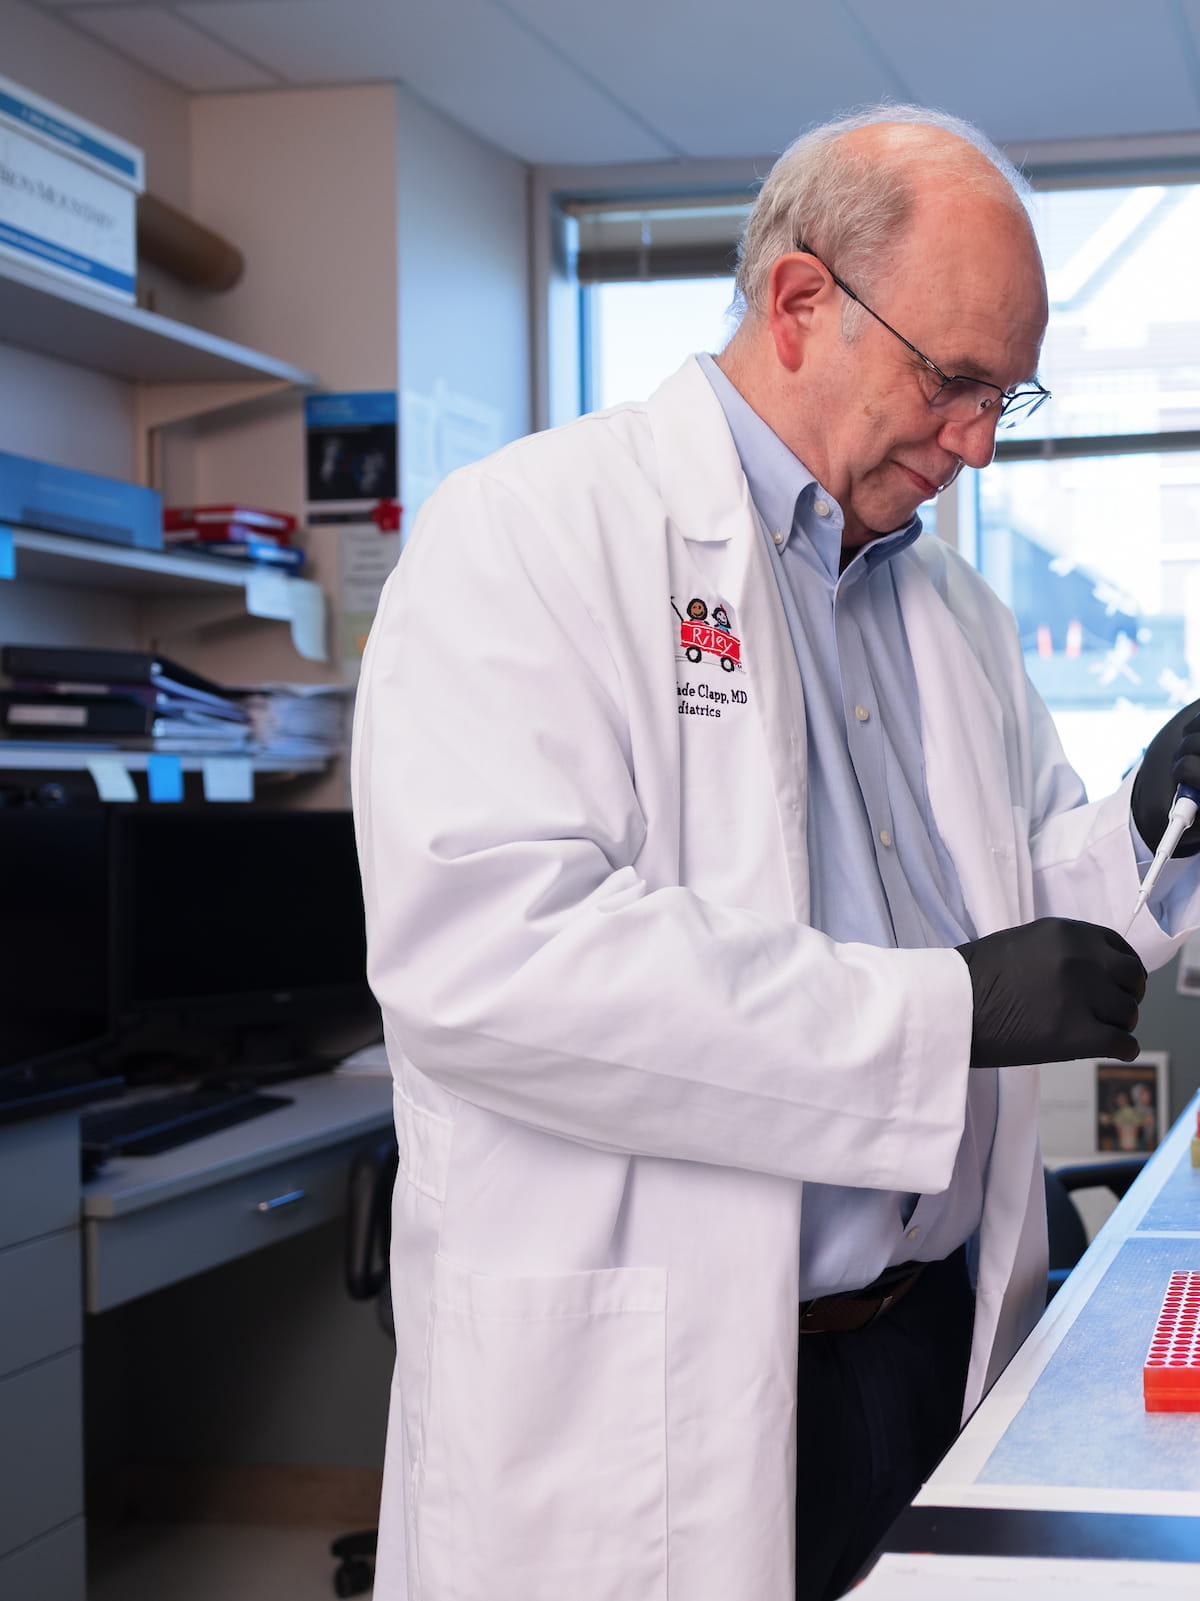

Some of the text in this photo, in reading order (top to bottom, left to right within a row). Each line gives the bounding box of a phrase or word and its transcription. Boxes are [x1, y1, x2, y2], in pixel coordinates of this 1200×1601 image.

[692, 627, 733, 655] Riley
[698, 684, 729, 704] Clapp,
[731, 689, 748, 704] MD
